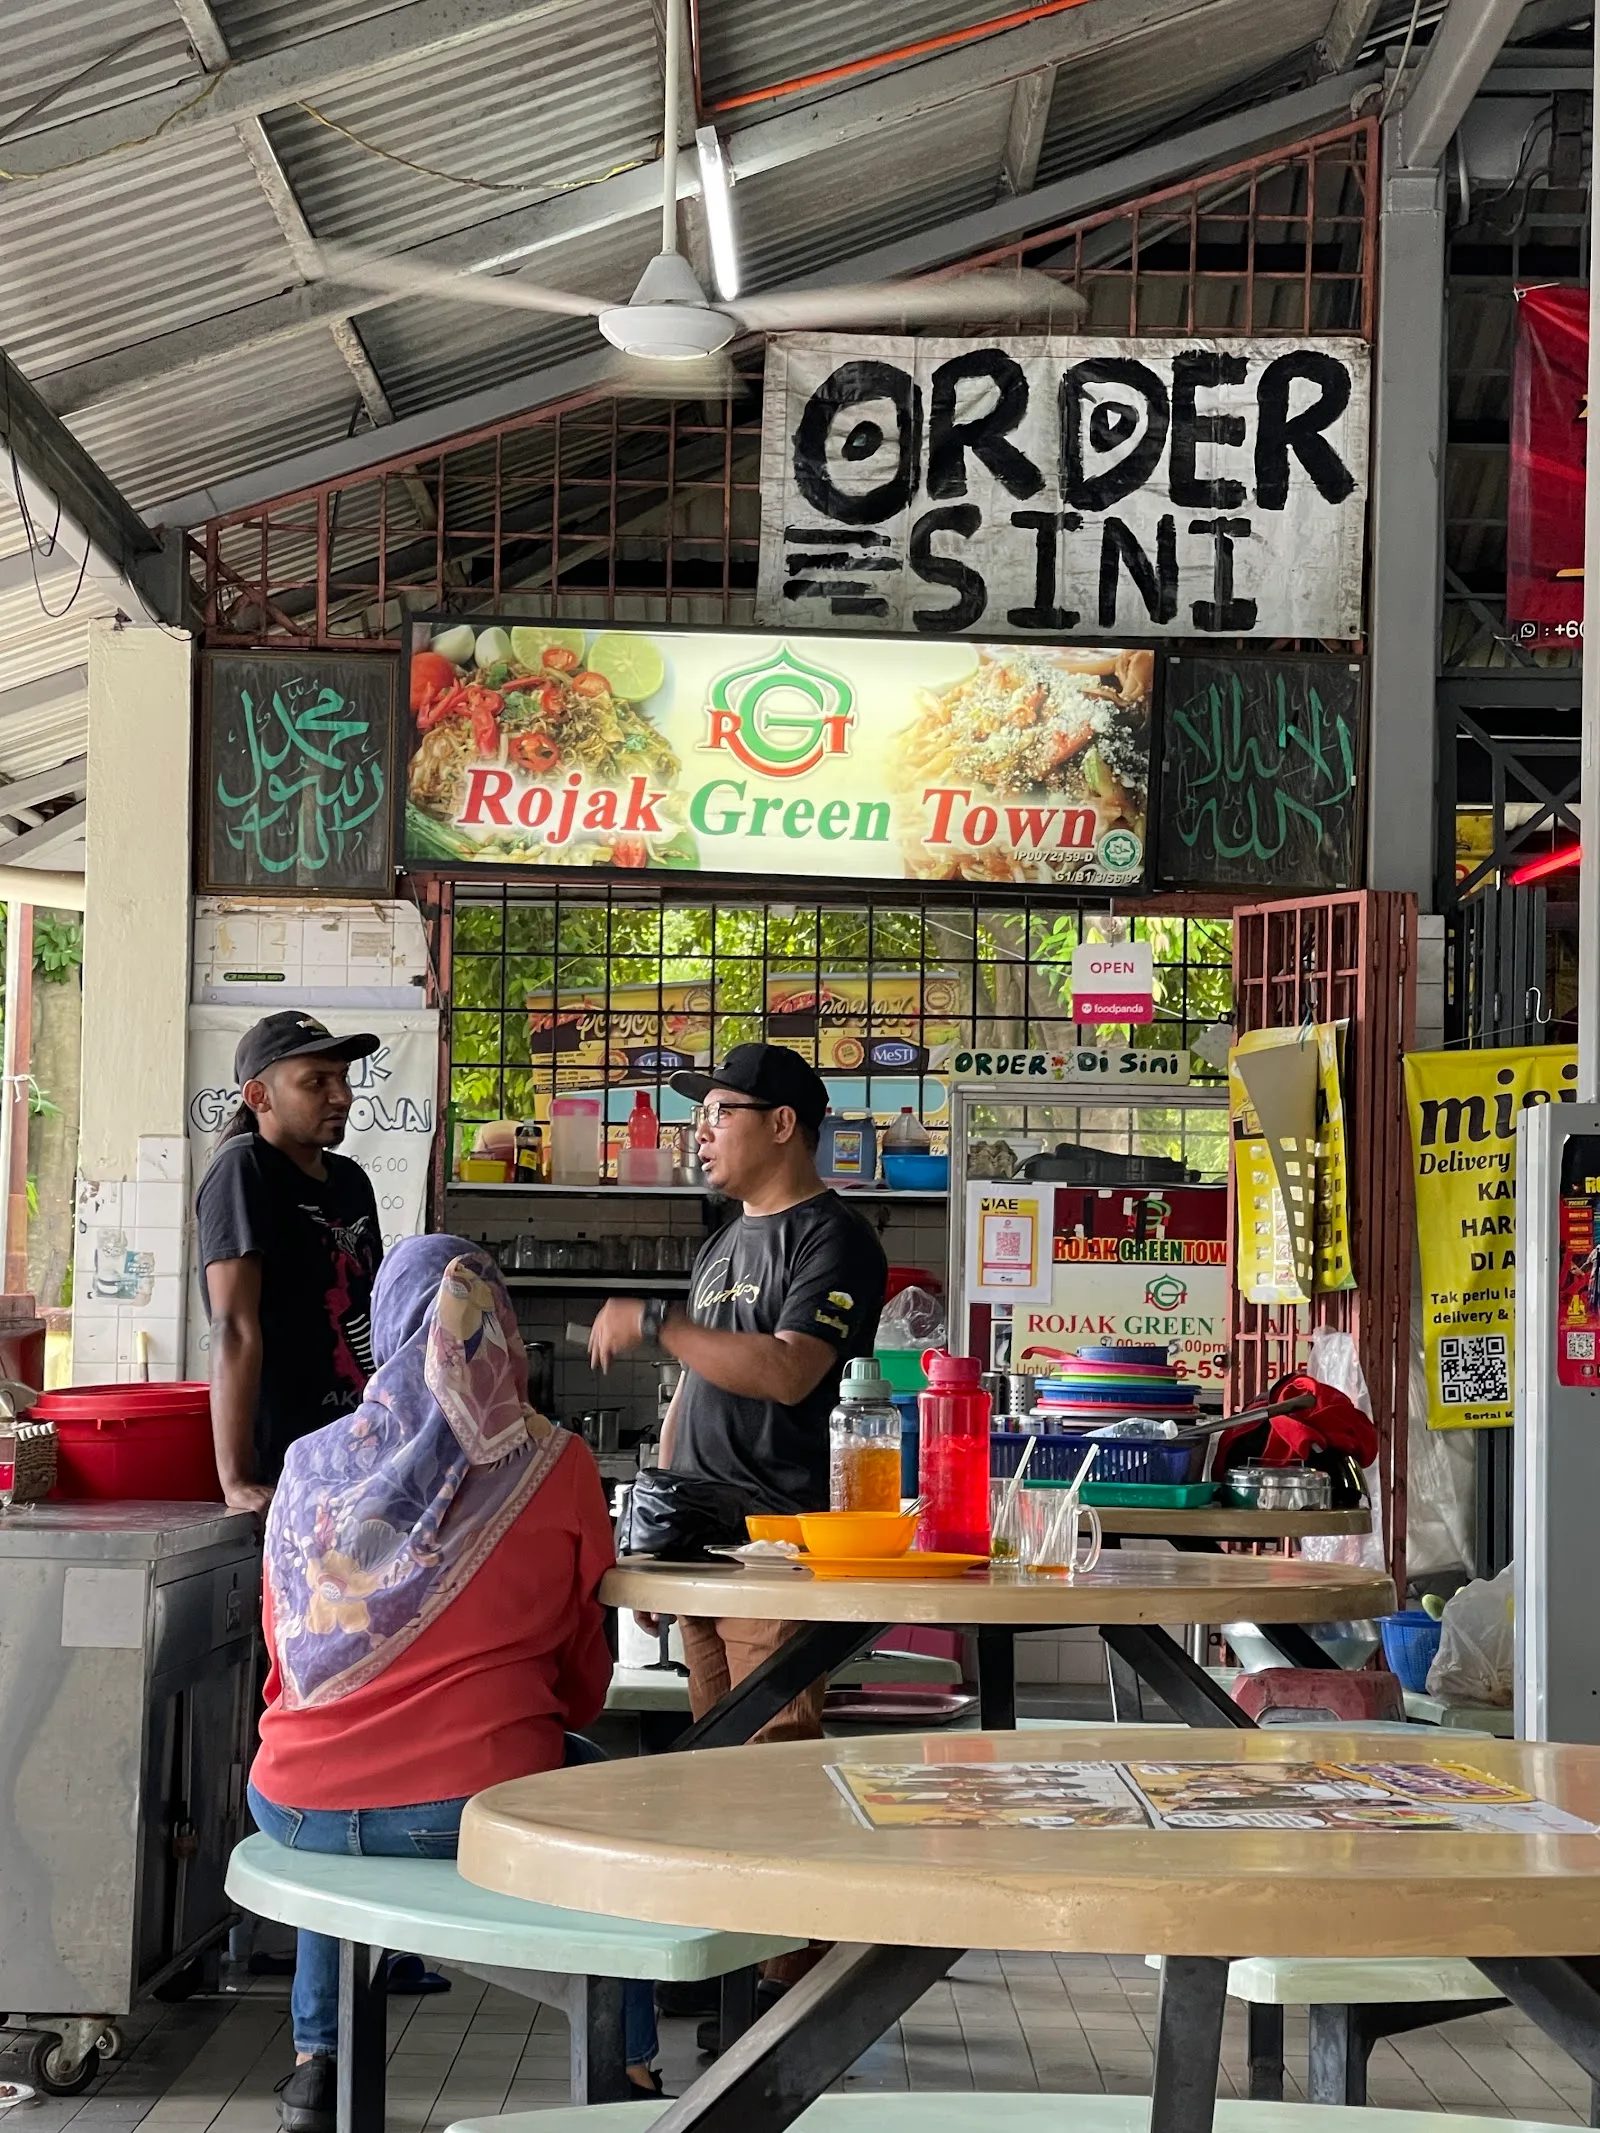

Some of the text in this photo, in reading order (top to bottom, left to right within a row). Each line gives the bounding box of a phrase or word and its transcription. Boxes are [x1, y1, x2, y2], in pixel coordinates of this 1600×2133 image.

[792, 348, 1356, 526] ORDER
[909, 502, 1259, 632] SINI
[456, 766, 1098, 849] Rojak Green Town
[1013, 850, 1094, 863] IP0072159-D
[1090, 961, 1136, 975] OPEN
[1093, 1002, 1144, 1015] foodpanda
[822, 1029, 906, 1037] VIRAL
[872, 1048, 914, 1062] MeSTI
[954, 1051, 1049, 1076] ORDER
[1118, 1053, 1179, 1075] Sini
[1419, 1150, 1511, 1175] Delivery
[1461, 1215, 1516, 1238] HAR
[1053, 1236, 1118, 1262] ROJAK
[1470, 1252, 1494, 1271] DI
[1430, 1291, 1458, 1304] Tak
[1462, 1288, 1500, 1305] perlu
[1027, 1314, 1117, 1335] ROJAK
[1123, 1315, 1213, 1336] GREEN
[1433, 1309, 1509, 1324] delivery &
